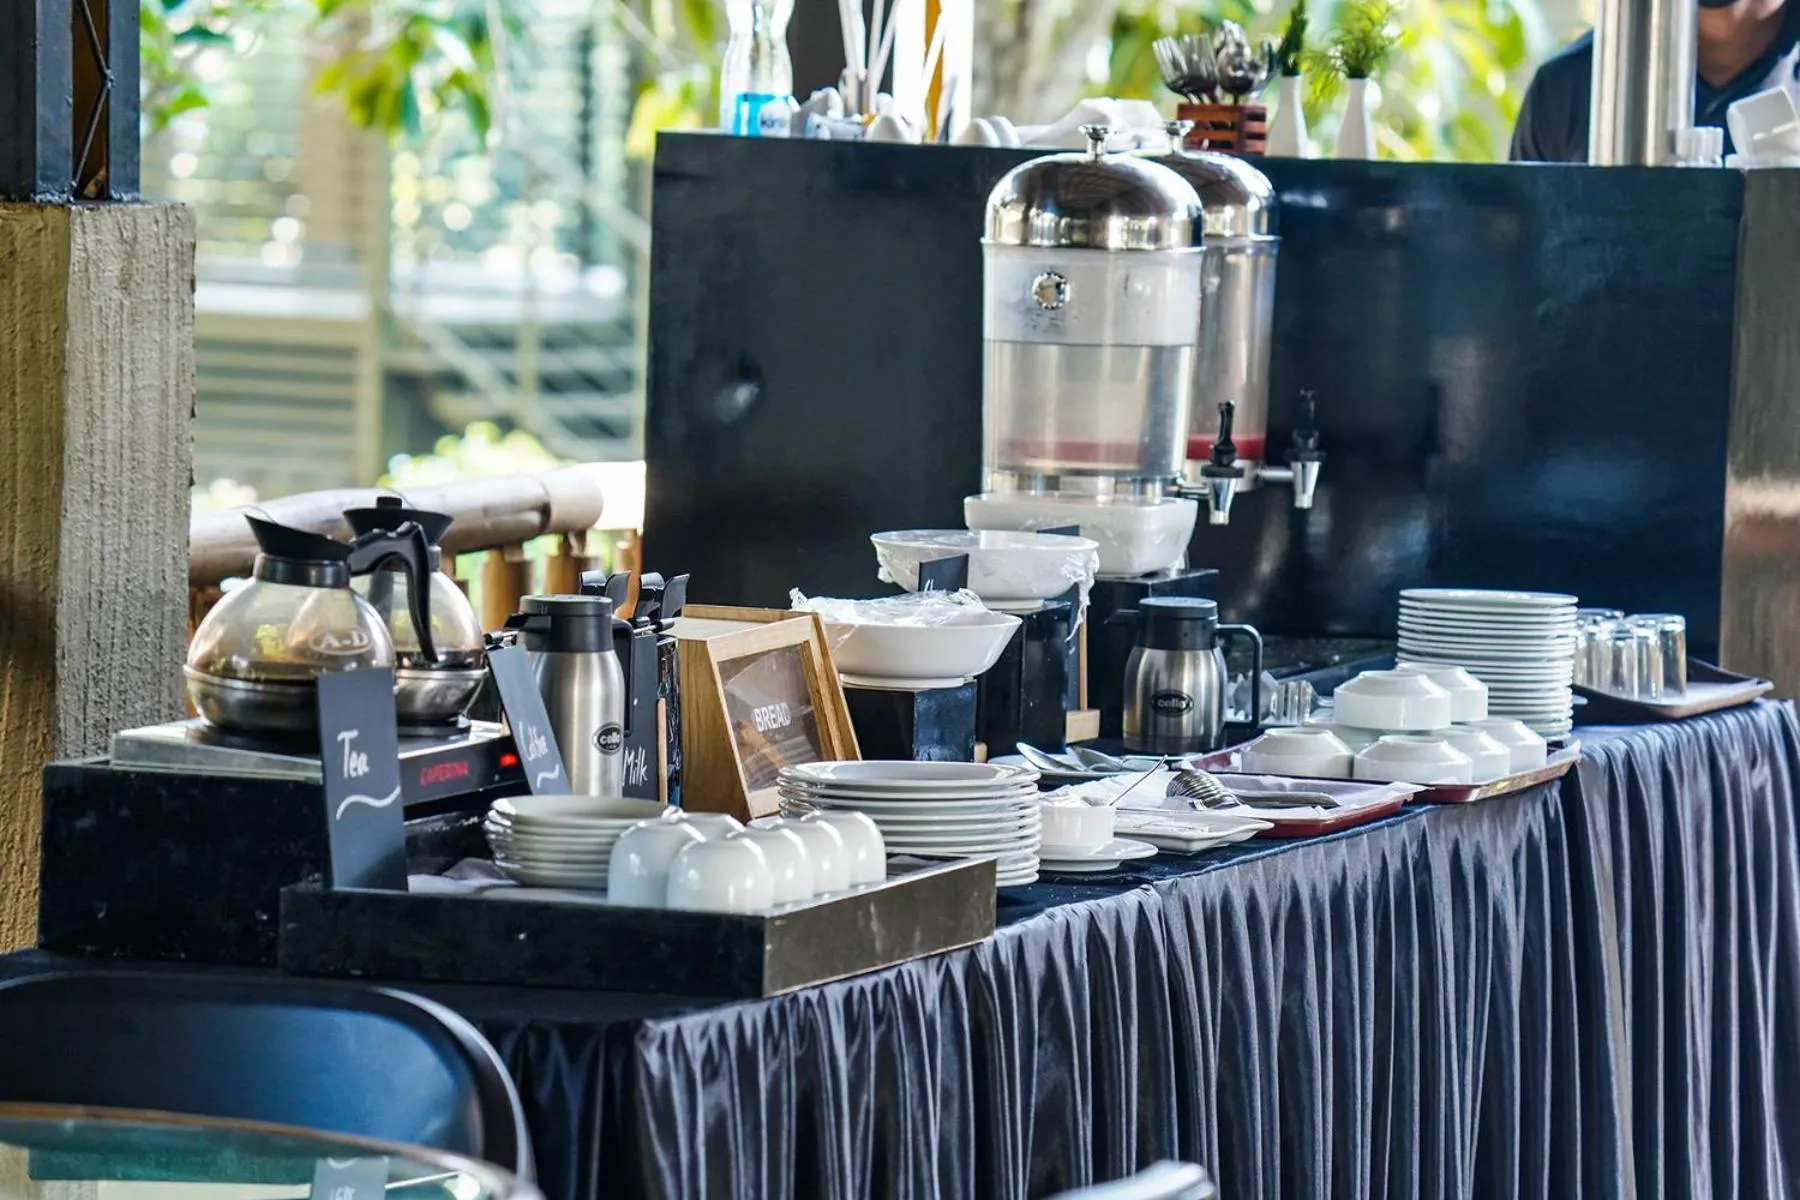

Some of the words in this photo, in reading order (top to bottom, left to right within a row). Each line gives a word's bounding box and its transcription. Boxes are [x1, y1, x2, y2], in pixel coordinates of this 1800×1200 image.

[752, 702, 791, 732] BREAD
[1157, 698, 1186, 709] cello
[337, 729, 369, 778] Tea
[622, 745, 648, 786] Milk
